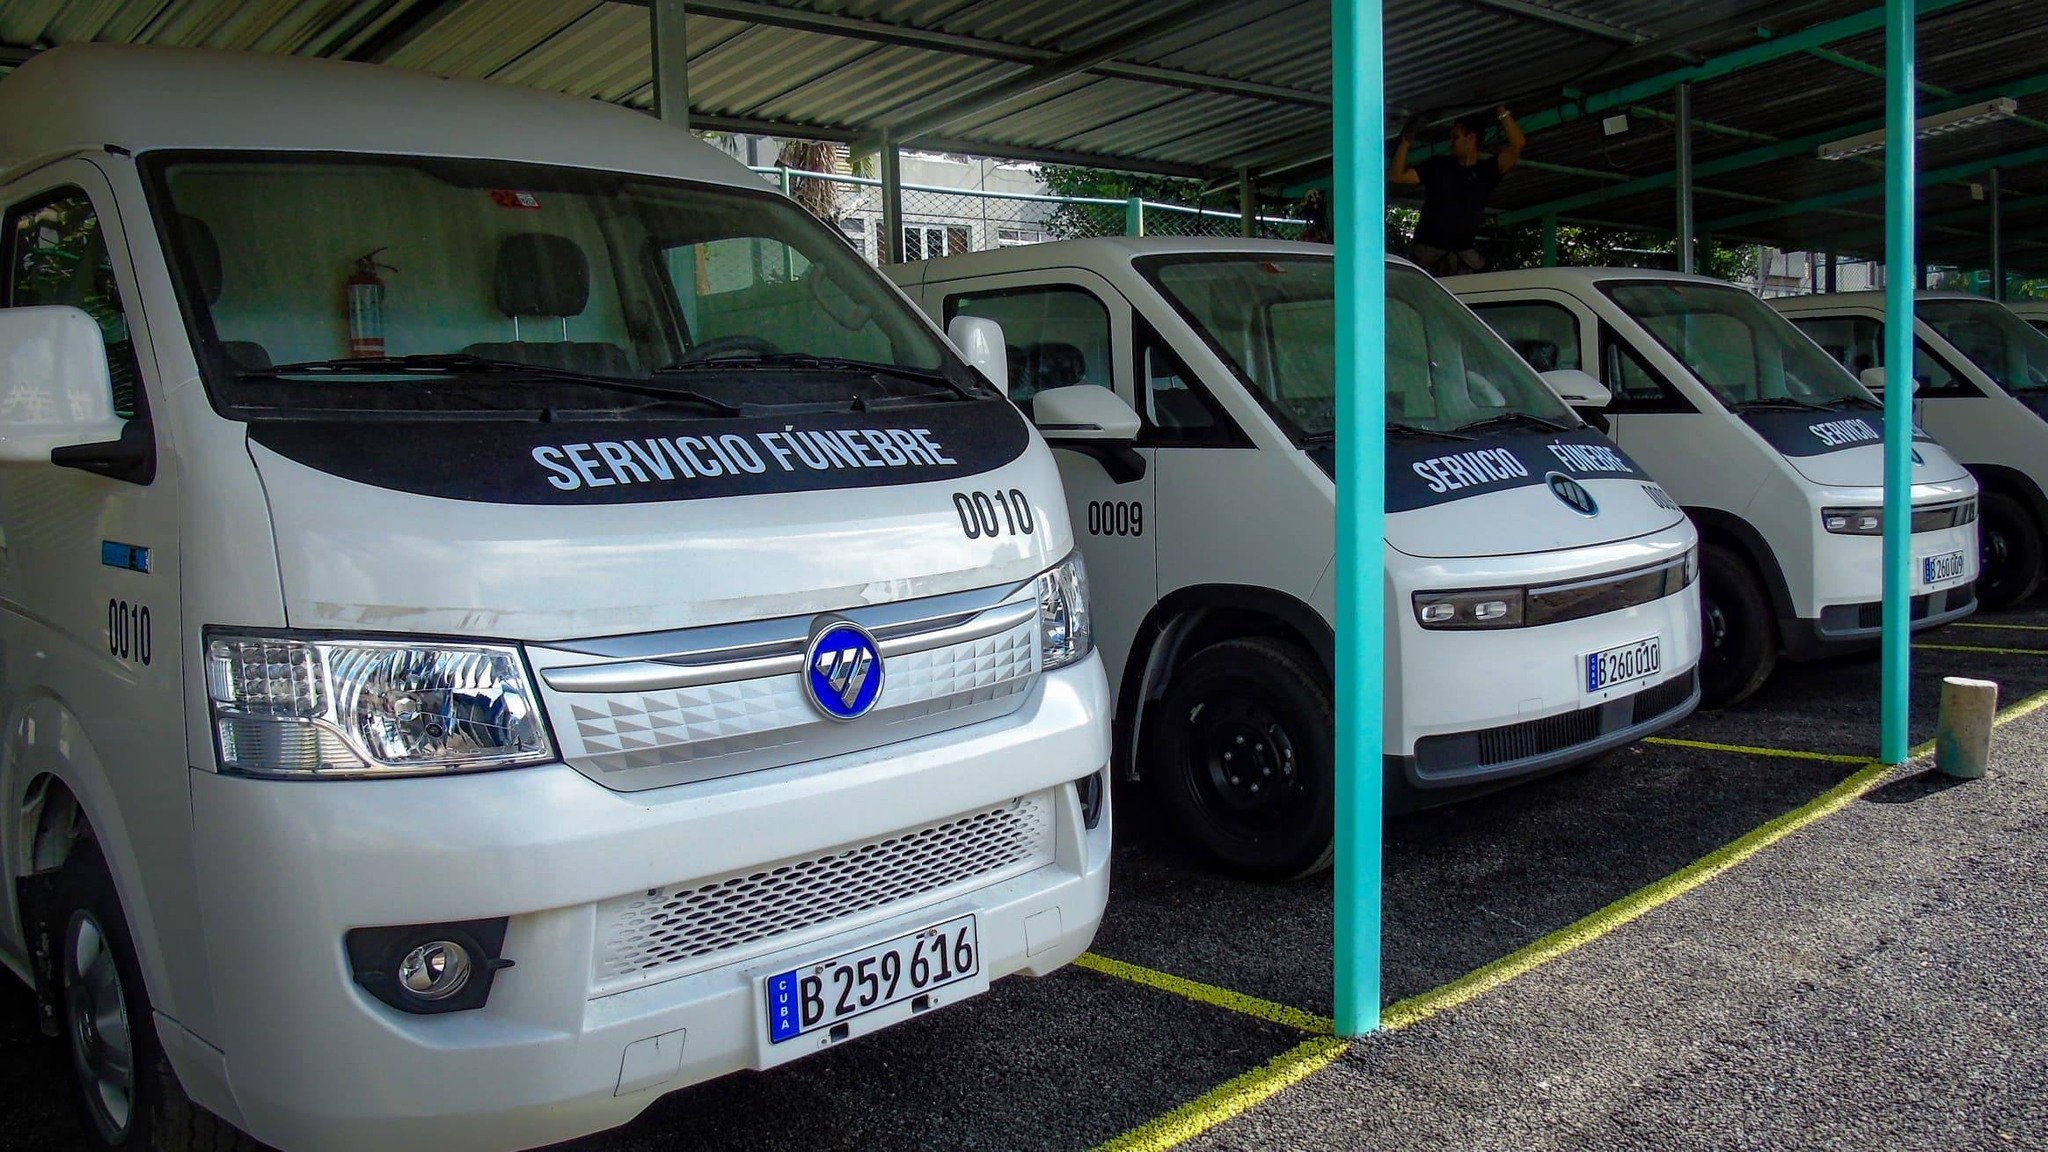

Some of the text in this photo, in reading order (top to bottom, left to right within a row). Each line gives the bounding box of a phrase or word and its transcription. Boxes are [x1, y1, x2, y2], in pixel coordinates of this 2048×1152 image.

[531, 424, 957, 491] SERVICIO FÚNEBRE
[1809, 418, 1879, 446] SERVICIO
[1412, 439, 1634, 493] SERVICIO FÚNEBRE
[951, 489, 1034, 540] 0010
[1088, 500, 1142, 536] 0009
[108, 598, 152, 667] 0010
[779, 980, 790, 1030] CUBA
